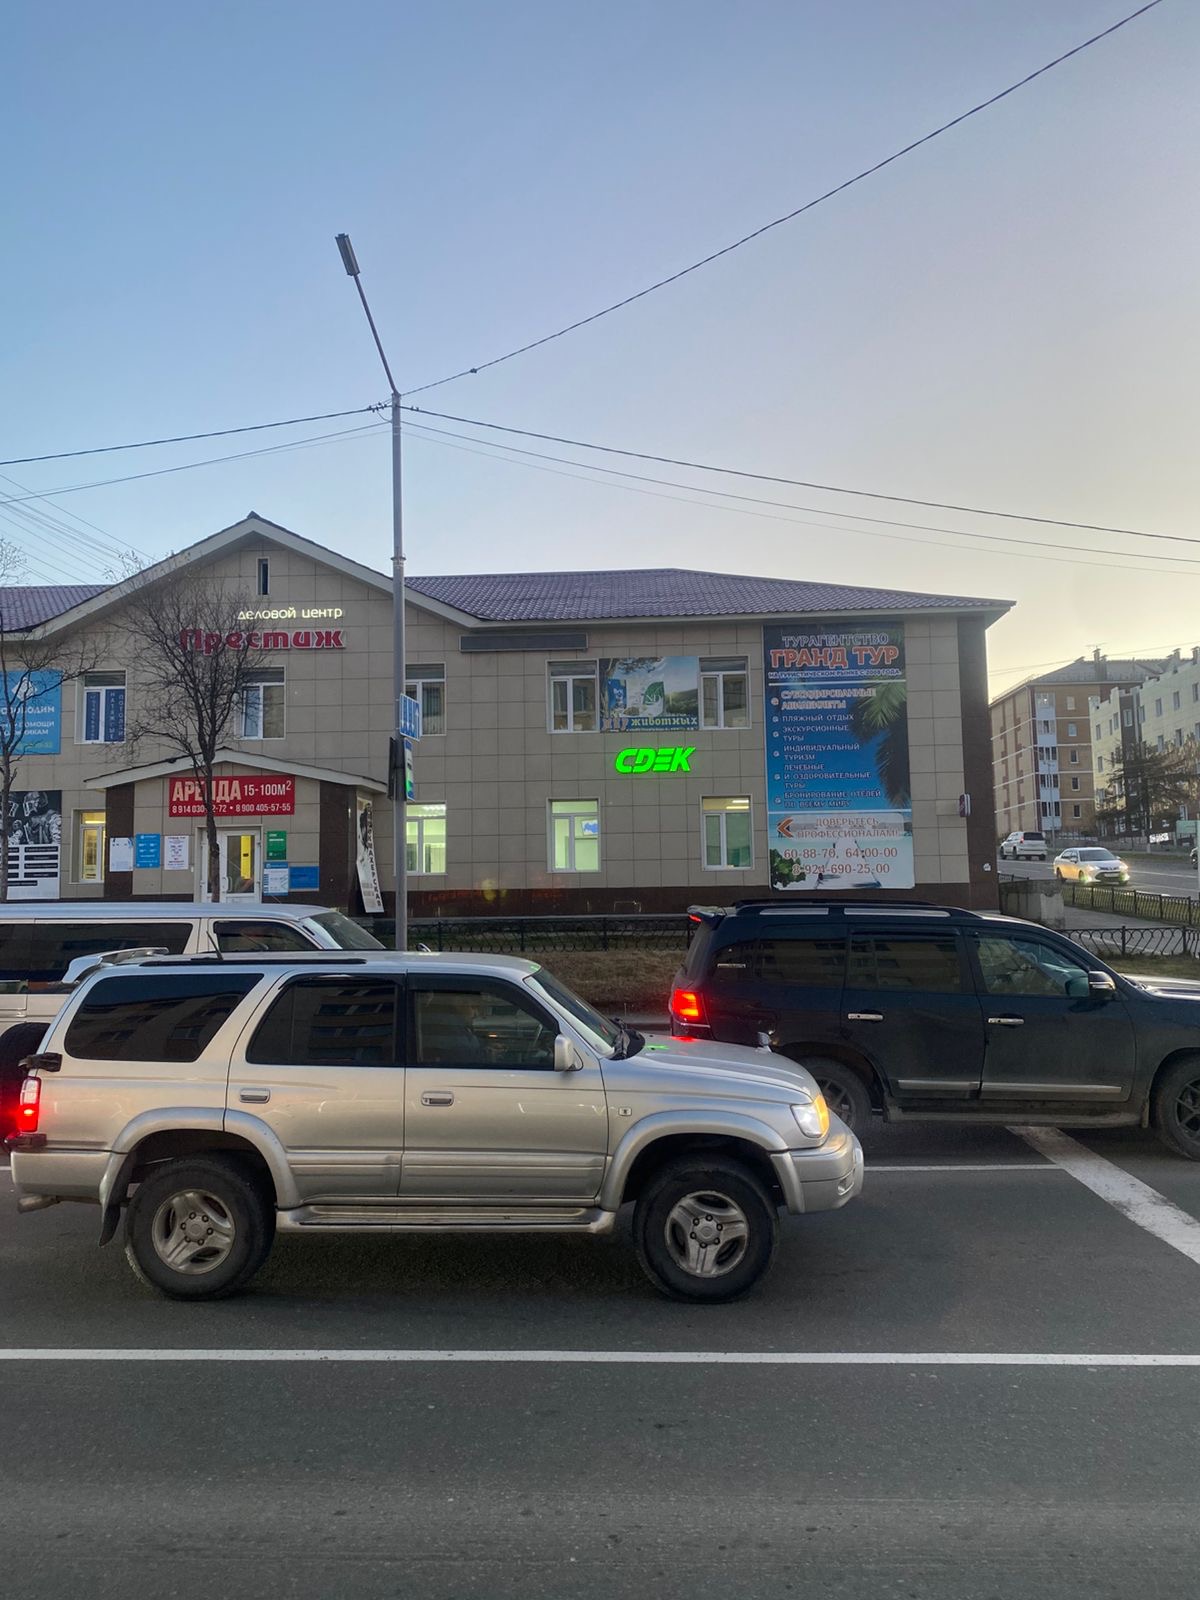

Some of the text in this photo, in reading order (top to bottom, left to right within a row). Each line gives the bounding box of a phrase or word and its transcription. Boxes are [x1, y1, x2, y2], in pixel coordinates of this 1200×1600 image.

[237, 607, 343, 620] деловой центр
[179, 628, 346, 655] Престиж
[782, 632, 889, 648] ТУРАГЕНТСТВО
[770, 646, 899, 669] ГРАНД ТУР
[782, 714, 823, 722] ПЛЯЖНЫЙ
[782, 725, 849, 733] ЭКСКУРСИОННЫЕ
[783, 744, 860, 752] ИНДИВИДУАЛЬНЫЙ
[615, 747, 696, 774] CDEK
[793, 772, 871, 780] ОЗДОРОВИТЕЛЬНЫЕ
[784, 791, 847, 799] БРОНИРОВАНИЕ
[845, 847, 898, 858] 64-00-00
